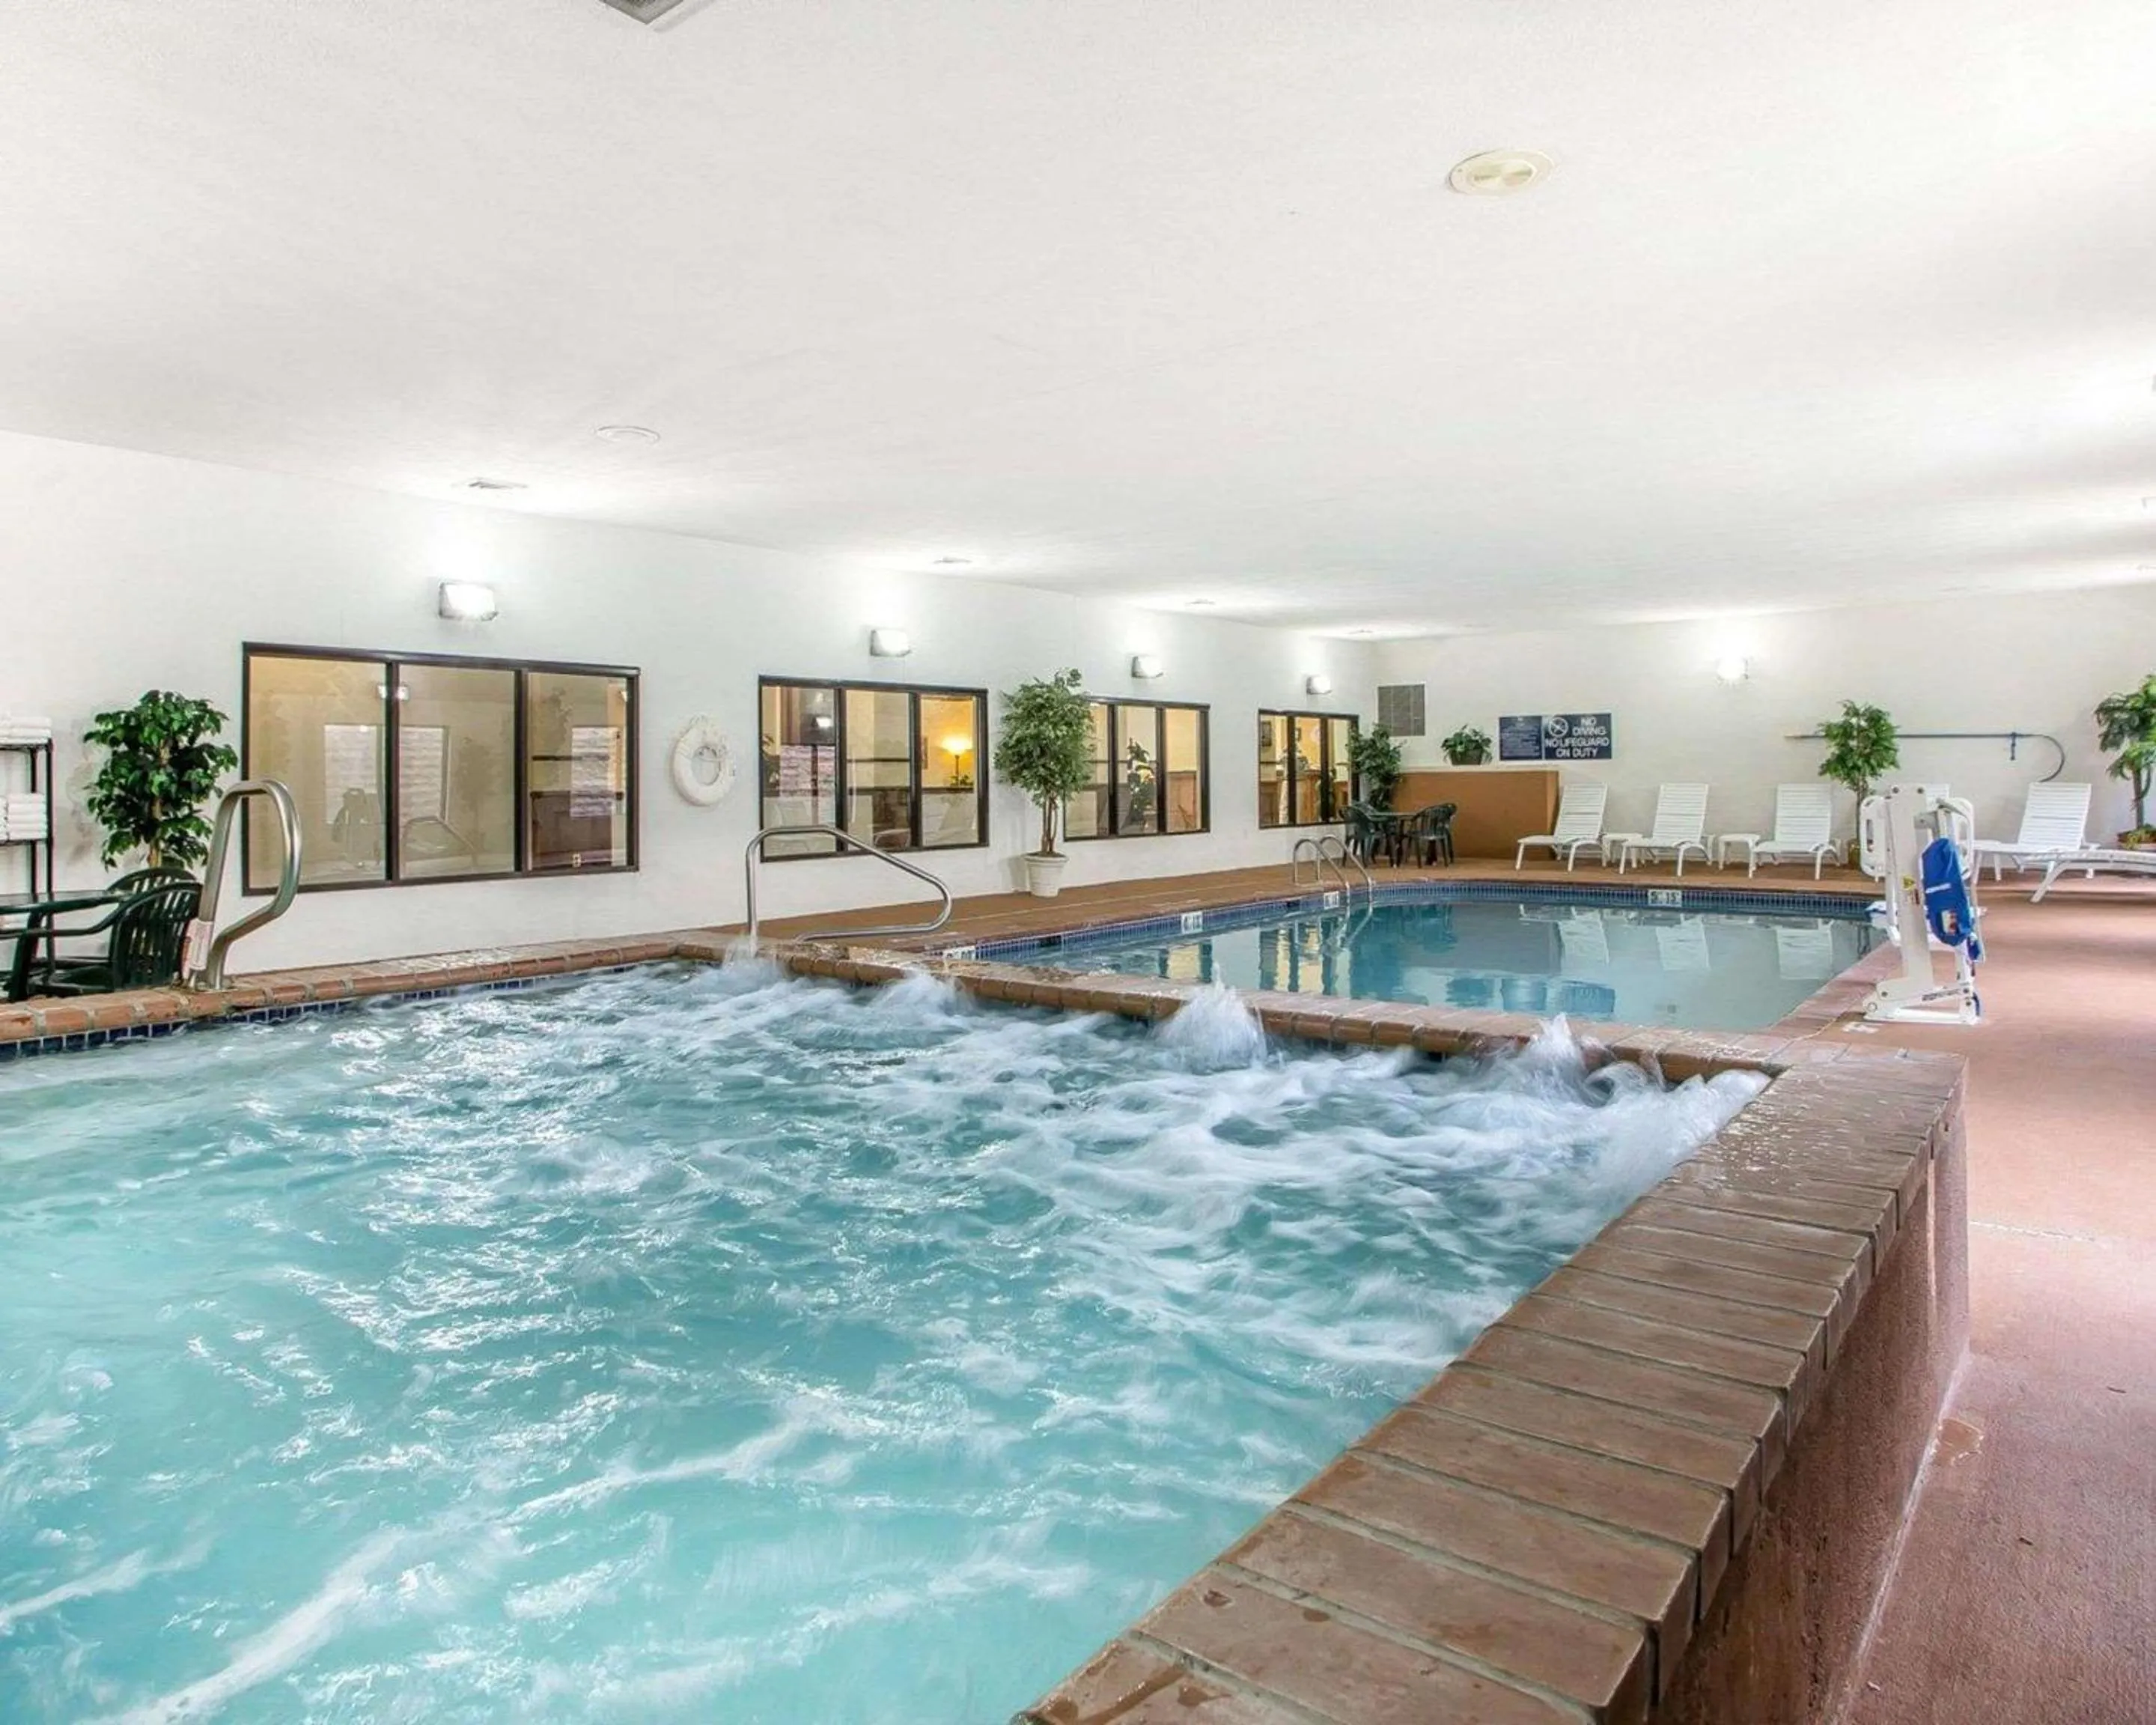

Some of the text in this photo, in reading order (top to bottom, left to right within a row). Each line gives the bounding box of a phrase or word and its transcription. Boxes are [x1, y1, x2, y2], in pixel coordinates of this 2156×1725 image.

[1581, 717, 1596, 726] NO
[1573, 726, 1606, 736] DIVING
[1544, 737, 1609, 747] NO LIFEGUARD
[1556, 748, 1598, 758] ON DUTY
